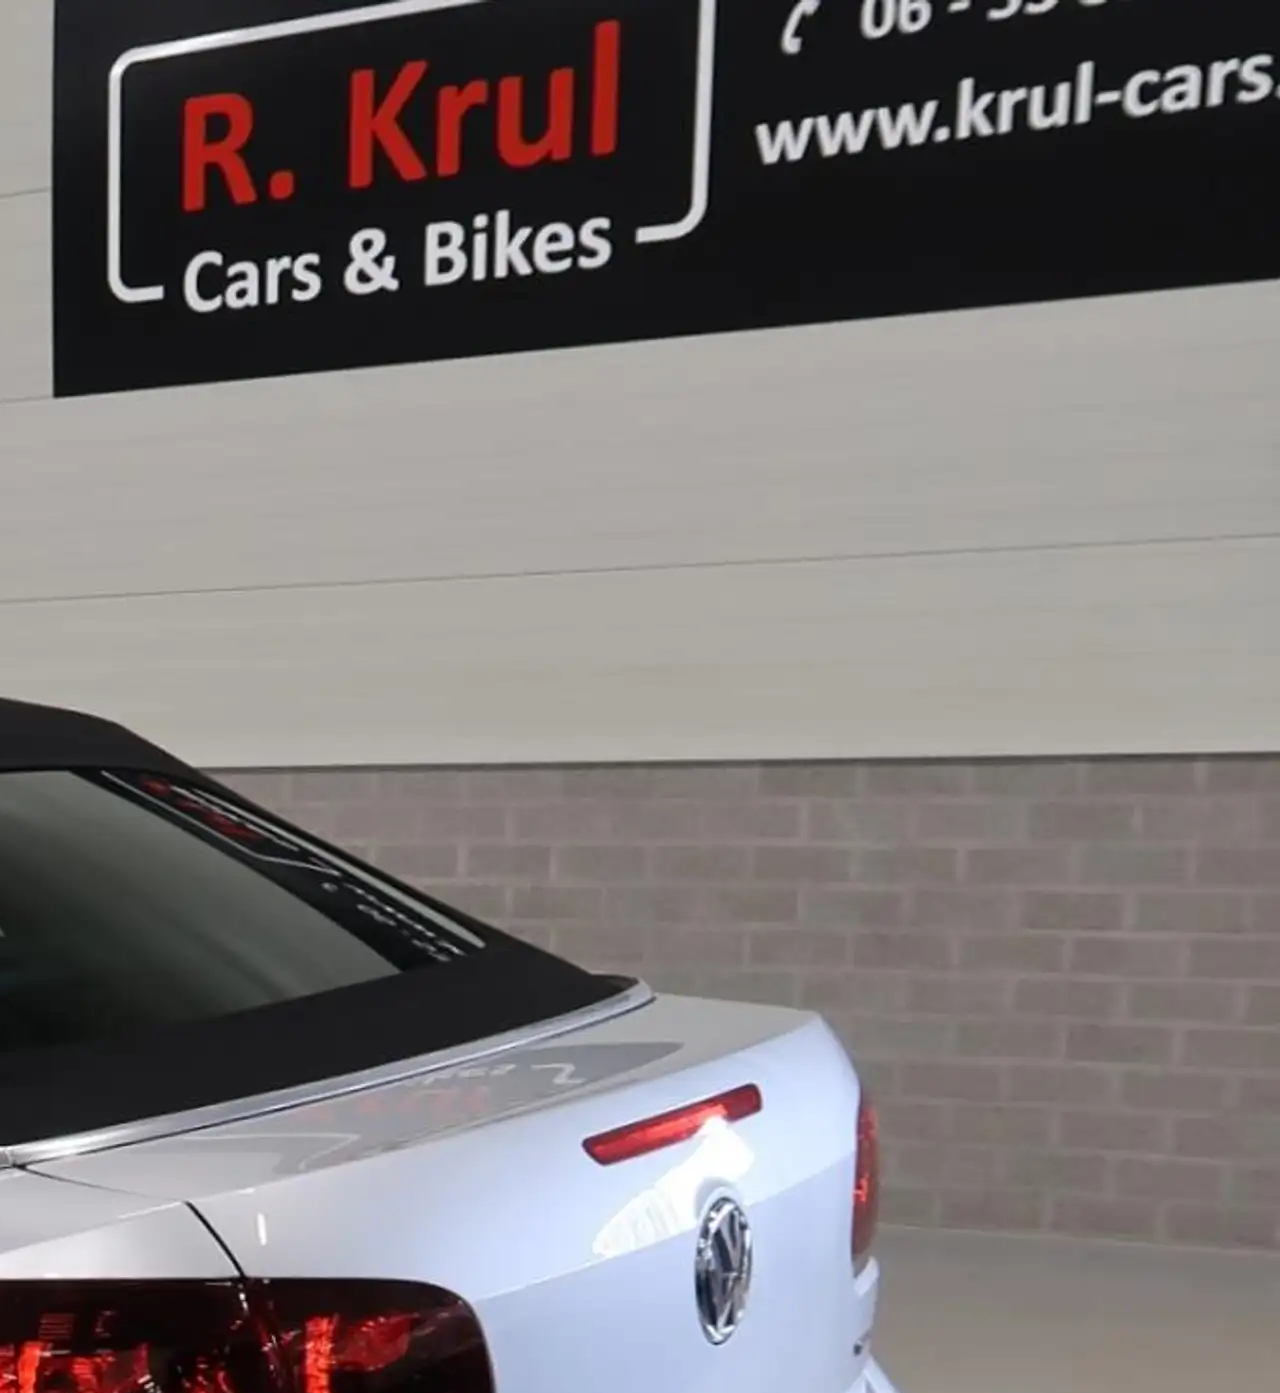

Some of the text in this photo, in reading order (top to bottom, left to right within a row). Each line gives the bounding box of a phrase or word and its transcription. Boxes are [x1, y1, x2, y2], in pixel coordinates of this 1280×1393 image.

[183, 19, 621, 213] R. Krul
[183, 209, 613, 313] Cars & Bikes
